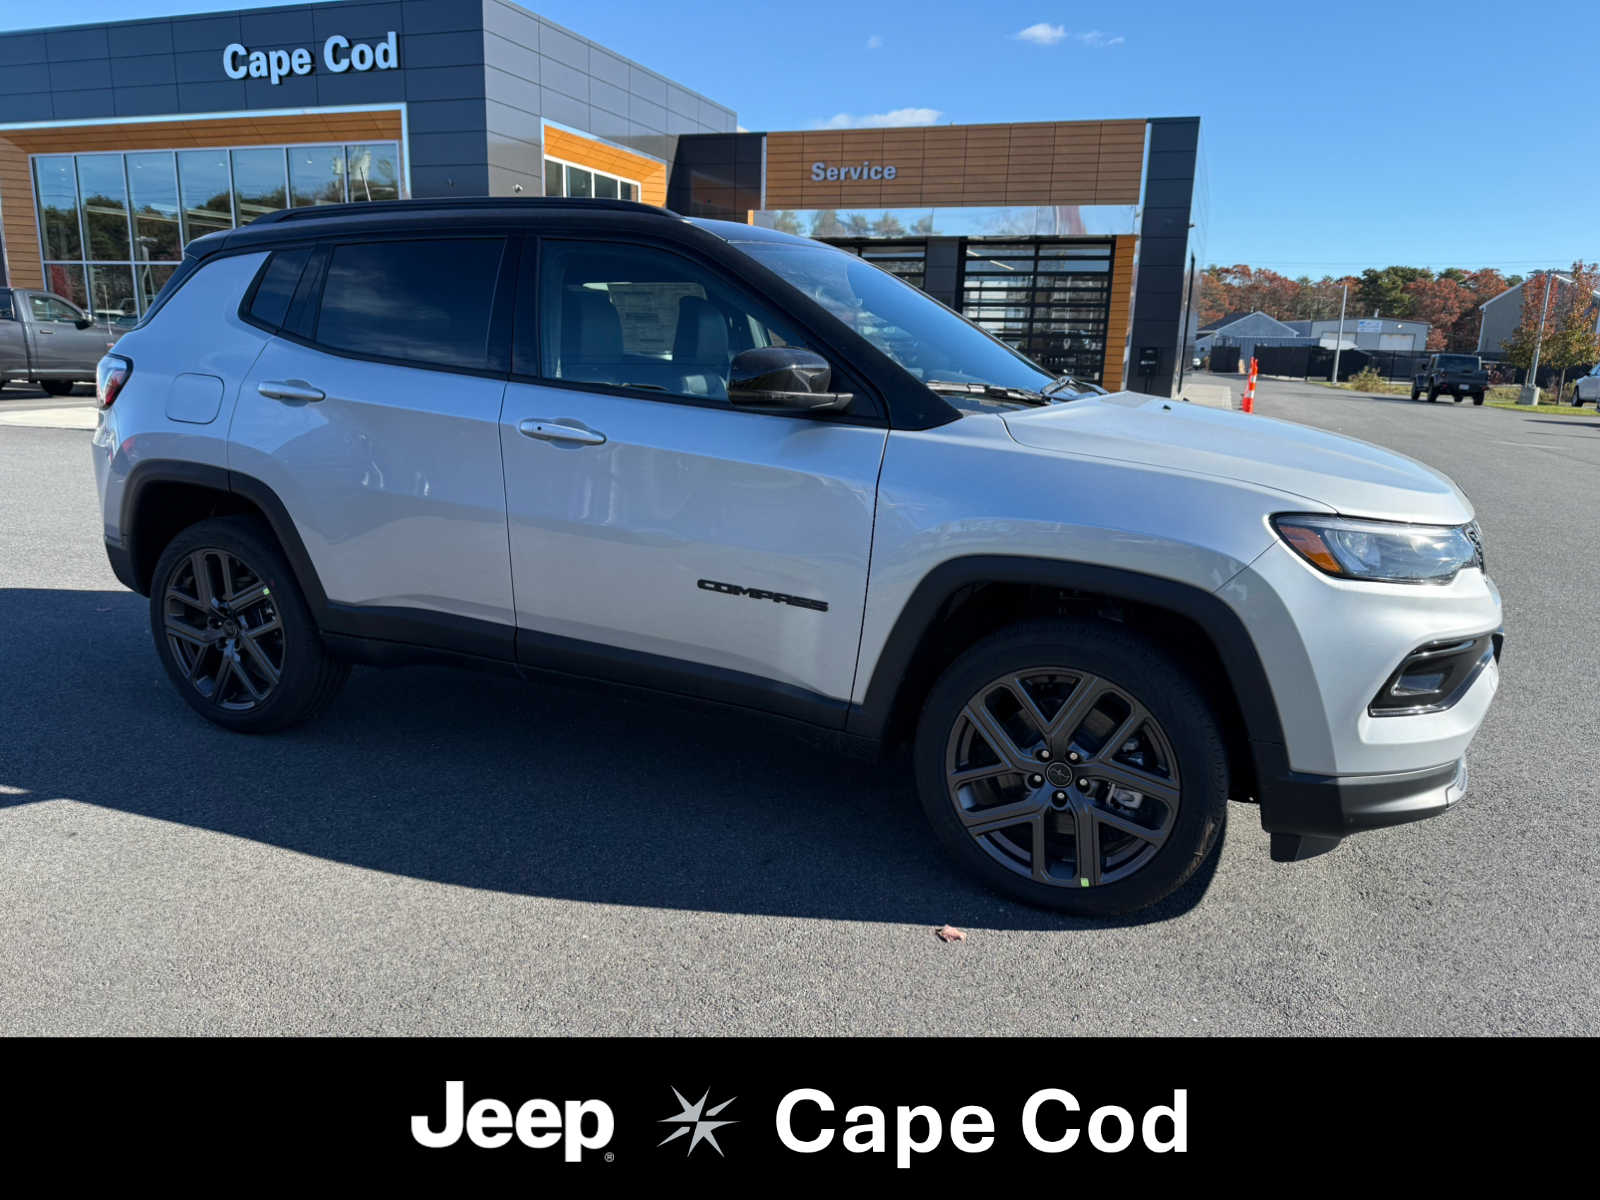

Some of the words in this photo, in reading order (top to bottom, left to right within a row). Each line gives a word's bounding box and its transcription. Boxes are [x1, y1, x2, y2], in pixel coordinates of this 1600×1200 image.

[223, 43, 312, 85] Cape
[323, 31, 398, 73] Cod
[811, 161, 897, 181] Service
[697, 579, 829, 612] COMPASS
